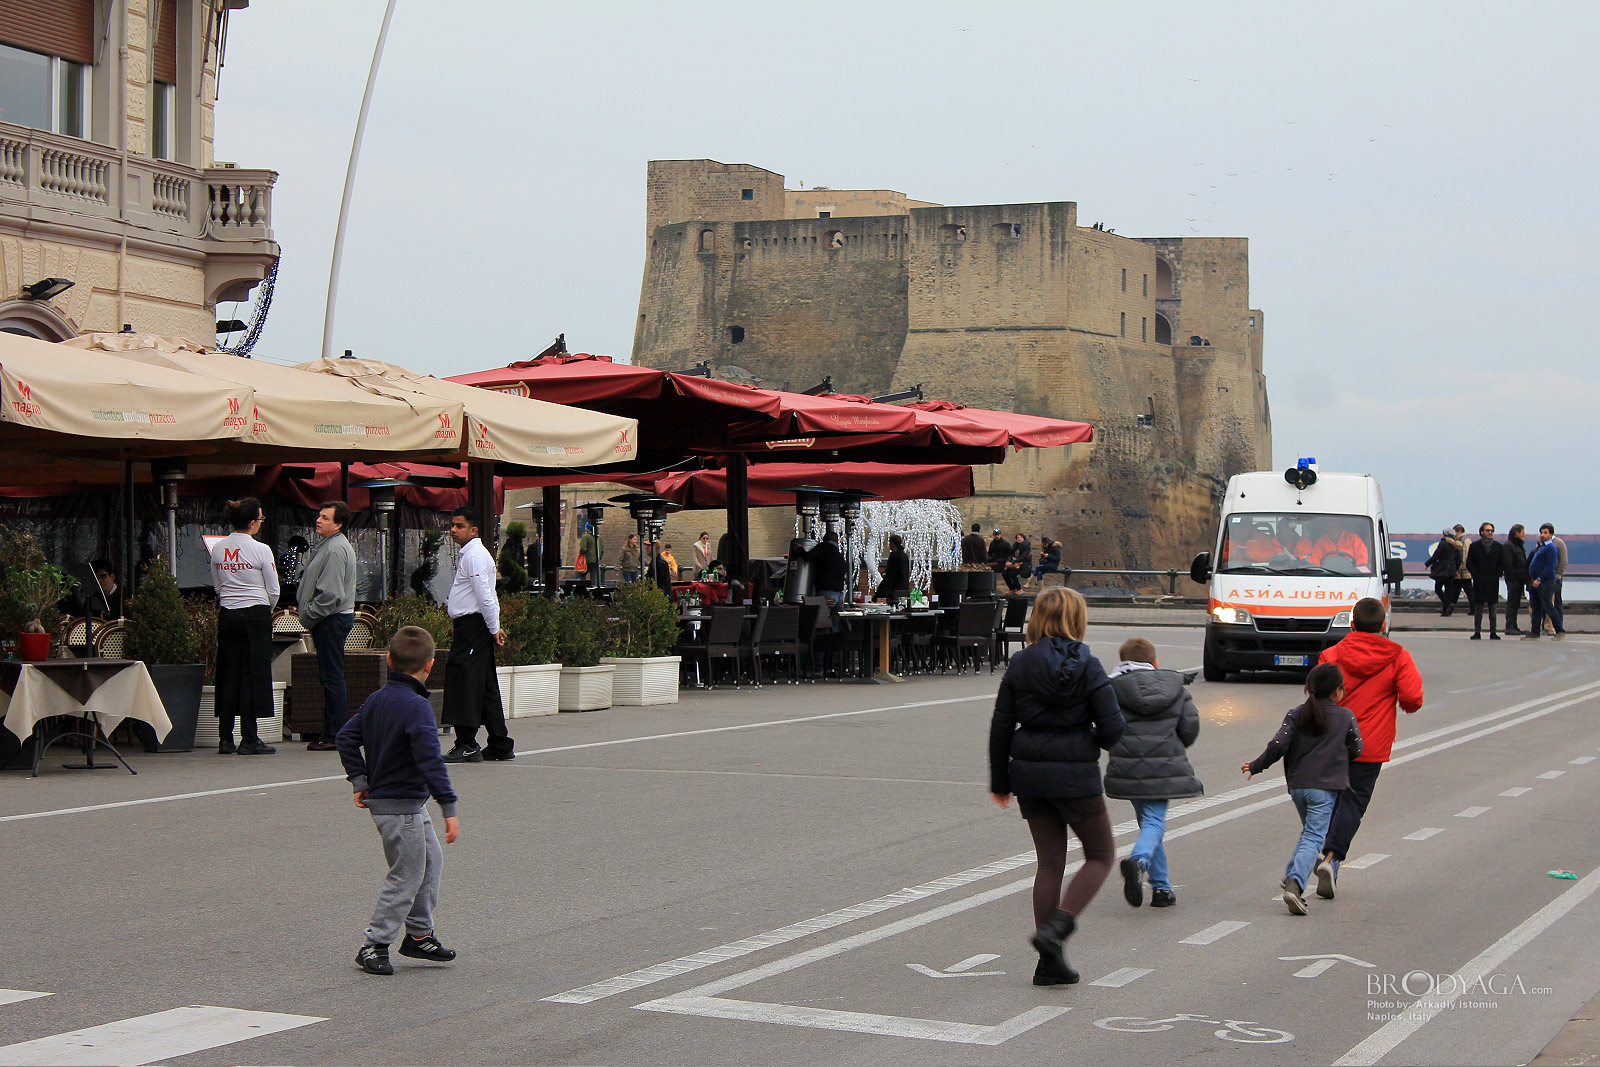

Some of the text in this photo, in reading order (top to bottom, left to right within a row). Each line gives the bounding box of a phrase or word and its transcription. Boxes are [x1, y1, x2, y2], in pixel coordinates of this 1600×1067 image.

[227, 397, 240, 415] M
[223, 416, 248, 431] magno
[438, 413, 451, 429] M
[434, 429, 457, 443] magno
[223, 547, 241, 562] M
[216, 561, 253, 574] magno
